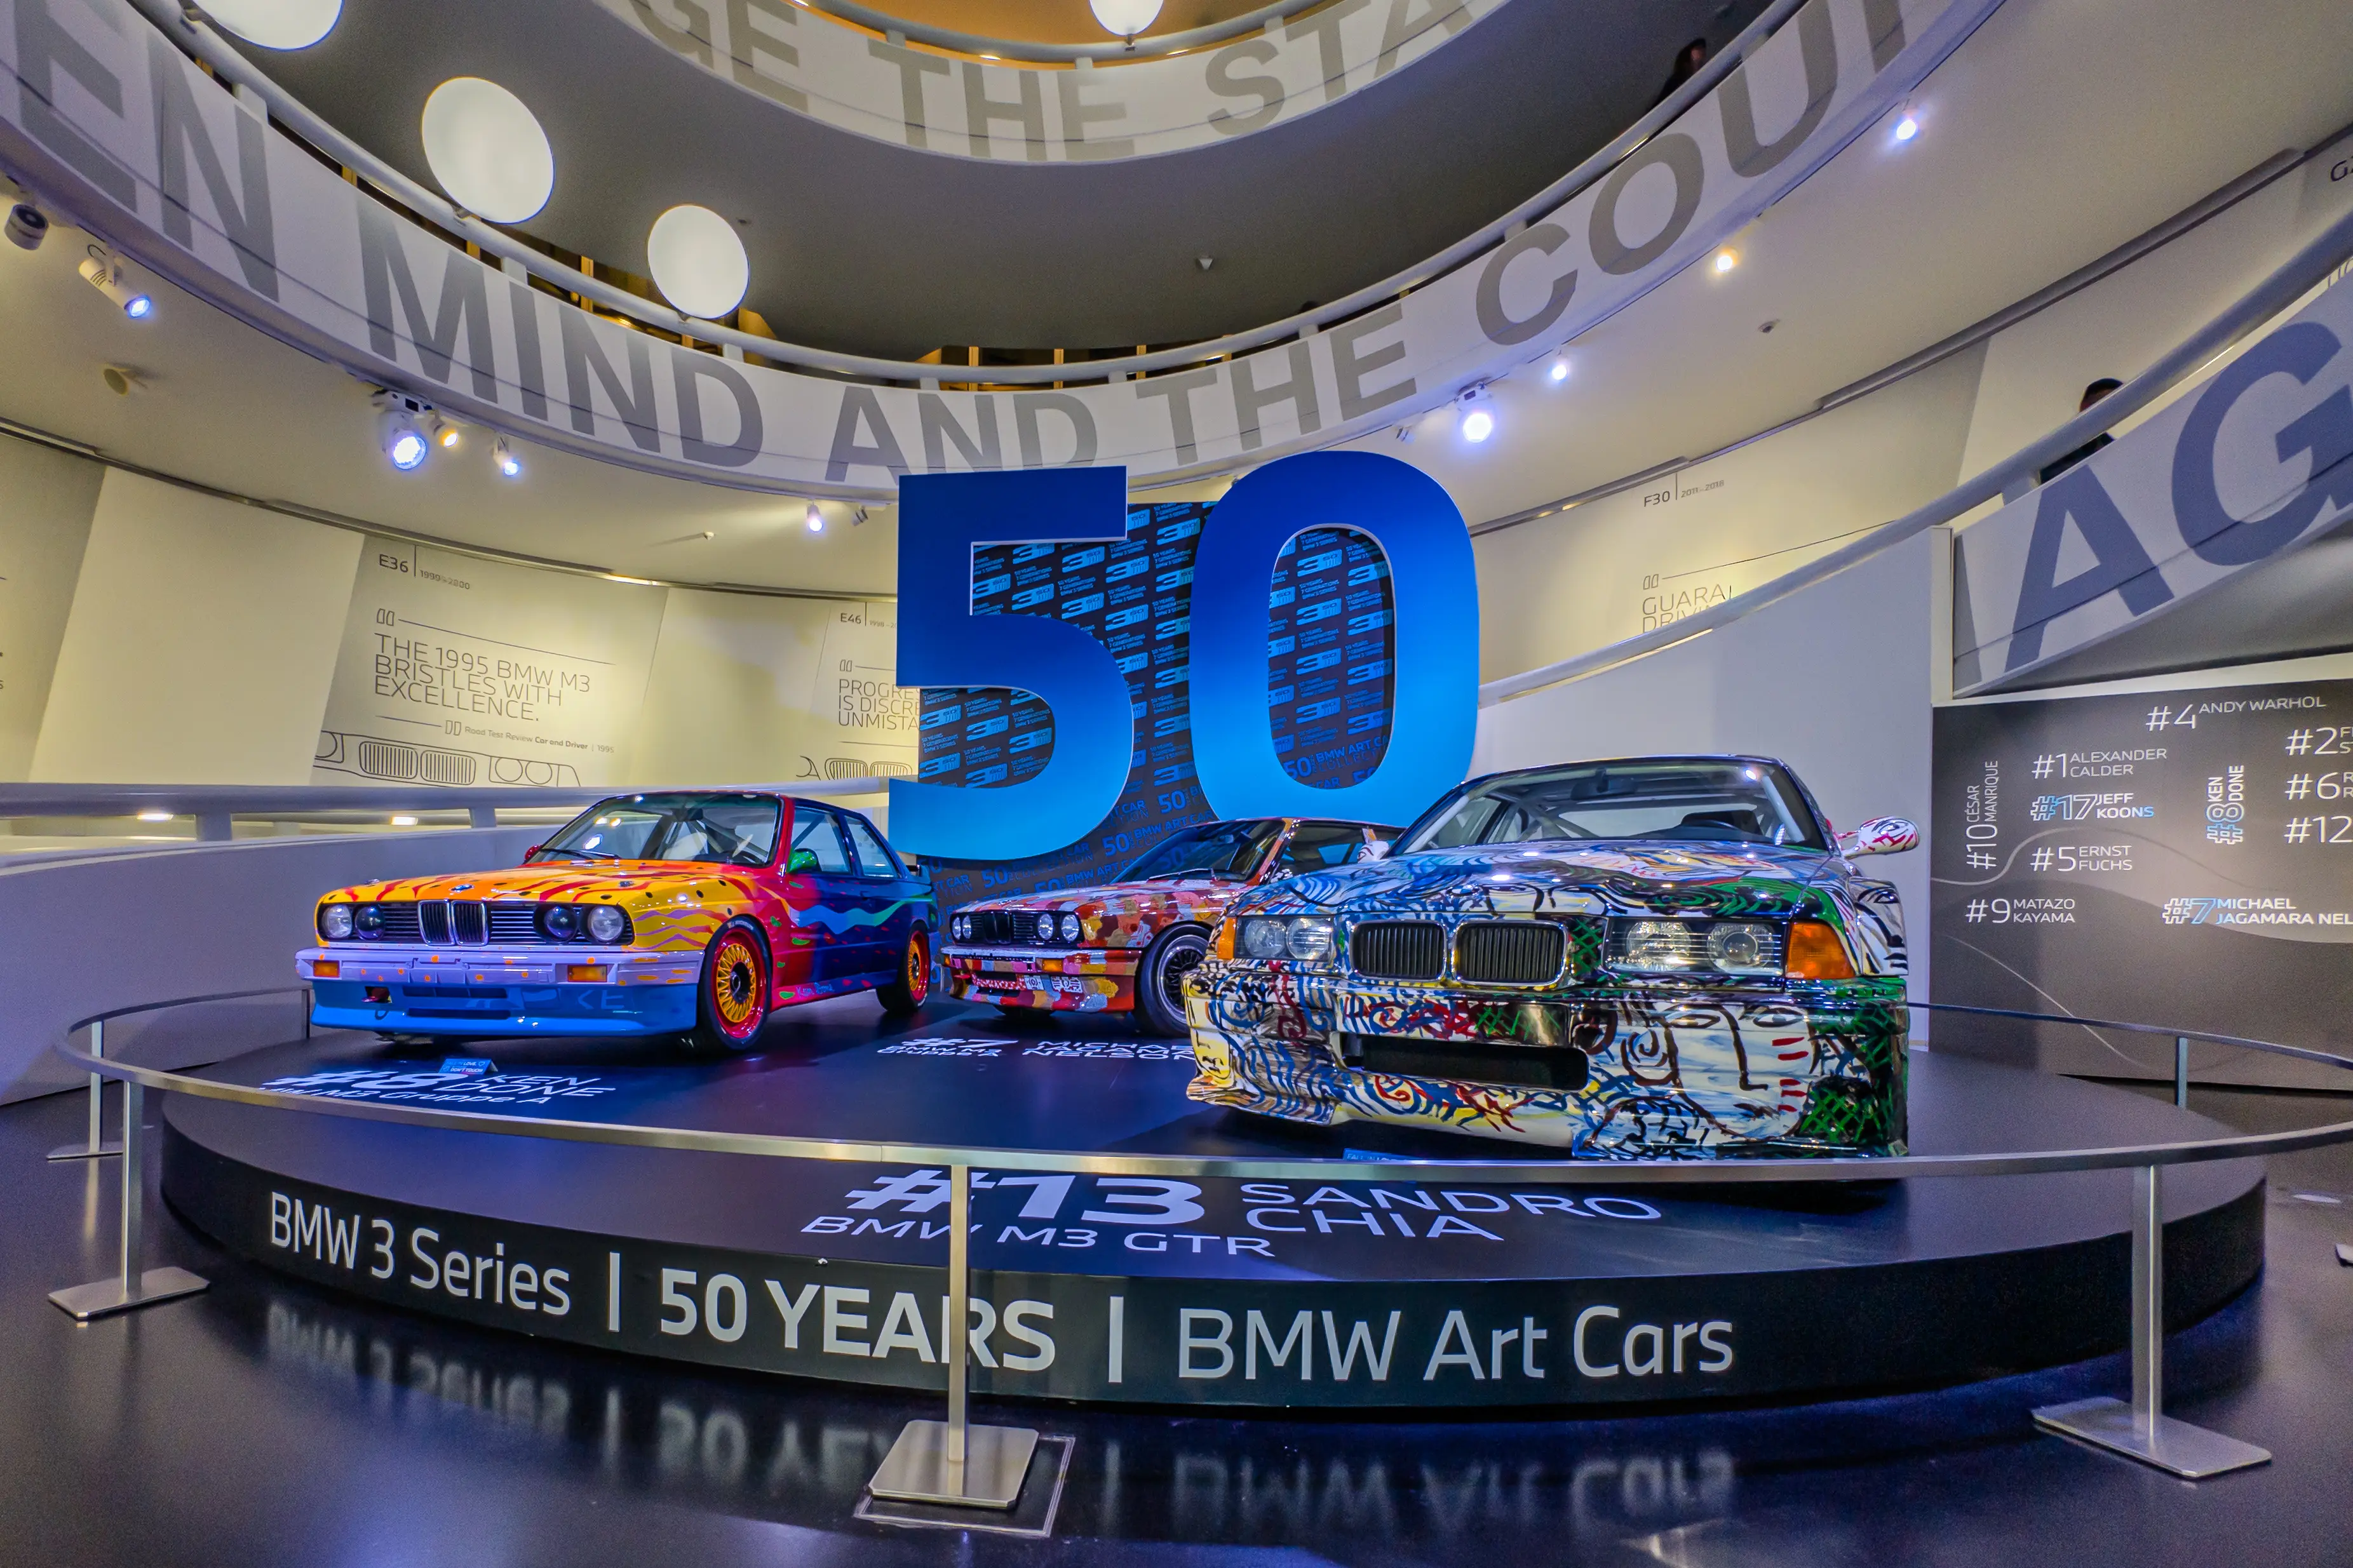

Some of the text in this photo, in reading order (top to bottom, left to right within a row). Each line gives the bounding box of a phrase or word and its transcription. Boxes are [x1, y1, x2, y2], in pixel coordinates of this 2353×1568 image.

[868, 38, 1136, 161] THE
[2331, 159, 2353, 182] G
[356, 187, 763, 467] MIND
[825, 386, 1098, 483] AND
[1135, 303, 1417, 466] THE
[1476, 0, 1906, 345] COU
[1644, 491, 1670, 507] F30
[1953, 321, 2353, 692] AG
[379, 554, 408, 573] E36
[840, 612, 861, 624] E46
[374, 633, 590, 692] THE 1995 BMW M3
[889, 451, 1480, 861] 50
[375, 654, 562, 706] BRISTLES WITH
[375, 675, 539, 721] EXCELLENCE.
[839, 695, 854, 711] IS
[2146, 697, 2327, 731] #4 ANDY WARHOL
[465, 726, 485, 735] Road
[489, 730, 503, 738] Test
[506, 732, 533, 742] Review
[565, 740, 588, 749] Driver
[597, 744, 614, 753] 1995
[2285, 727, 2338, 755] #2
[1284, 735, 1389, 780] 50 BMW ART CA
[2032, 748, 2168, 779] #1 ALEXANDER
[2070, 764, 2134, 777] CALDER
[1984, 760, 1999, 822] MANRIQUE
[2227, 765, 2244, 801] DONE
[2284, 772, 2340, 800] #6
[1122, 800, 1146, 814] CAR
[1158, 789, 1186, 814] 50
[2030, 793, 2134, 821] #17 JEFF
[2096, 806, 2154, 819] KOONS
[2206, 776, 2244, 845] #8 KEN
[1102, 810, 1214, 857] 50 BMW ART CAR
[1964, 784, 1998, 870] #10 CÉSAR
[2284, 815, 2353, 843] #12
[2030, 845, 2132, 872] #5 ERNST
[2079, 859, 2133, 871] FUCHS
[946, 874, 969, 888] CAR
[981, 865, 1009, 889] 50
[1065, 869, 1094, 887] BMW
[1096, 862, 1119, 877] ART
[1965, 898, 2075, 924] #9 MATAZO
[2013, 911, 2075, 923] KAYAMA
[2162, 897, 2297, 925] #7 MICHAEL
[2216, 913, 2314, 925] JAGAMARA
[902, 1038, 1019, 1048] #7
[1022, 1050, 1195, 1060] NELSON
[262, 1071, 601, 1089] #8 KEN
[433, 1083, 616, 1096] DONE
[379, 1092, 515, 1102] Gruppe
[845, 1170, 1662, 1225] #13 SANDRO
[800, 1216, 1275, 1256] BMW M3 GTR
[1246, 1208, 1504, 1241] CHIA
[271, 1192, 1737, 1382] BMW 3 Series 50 YEARS BMW Art Cars
